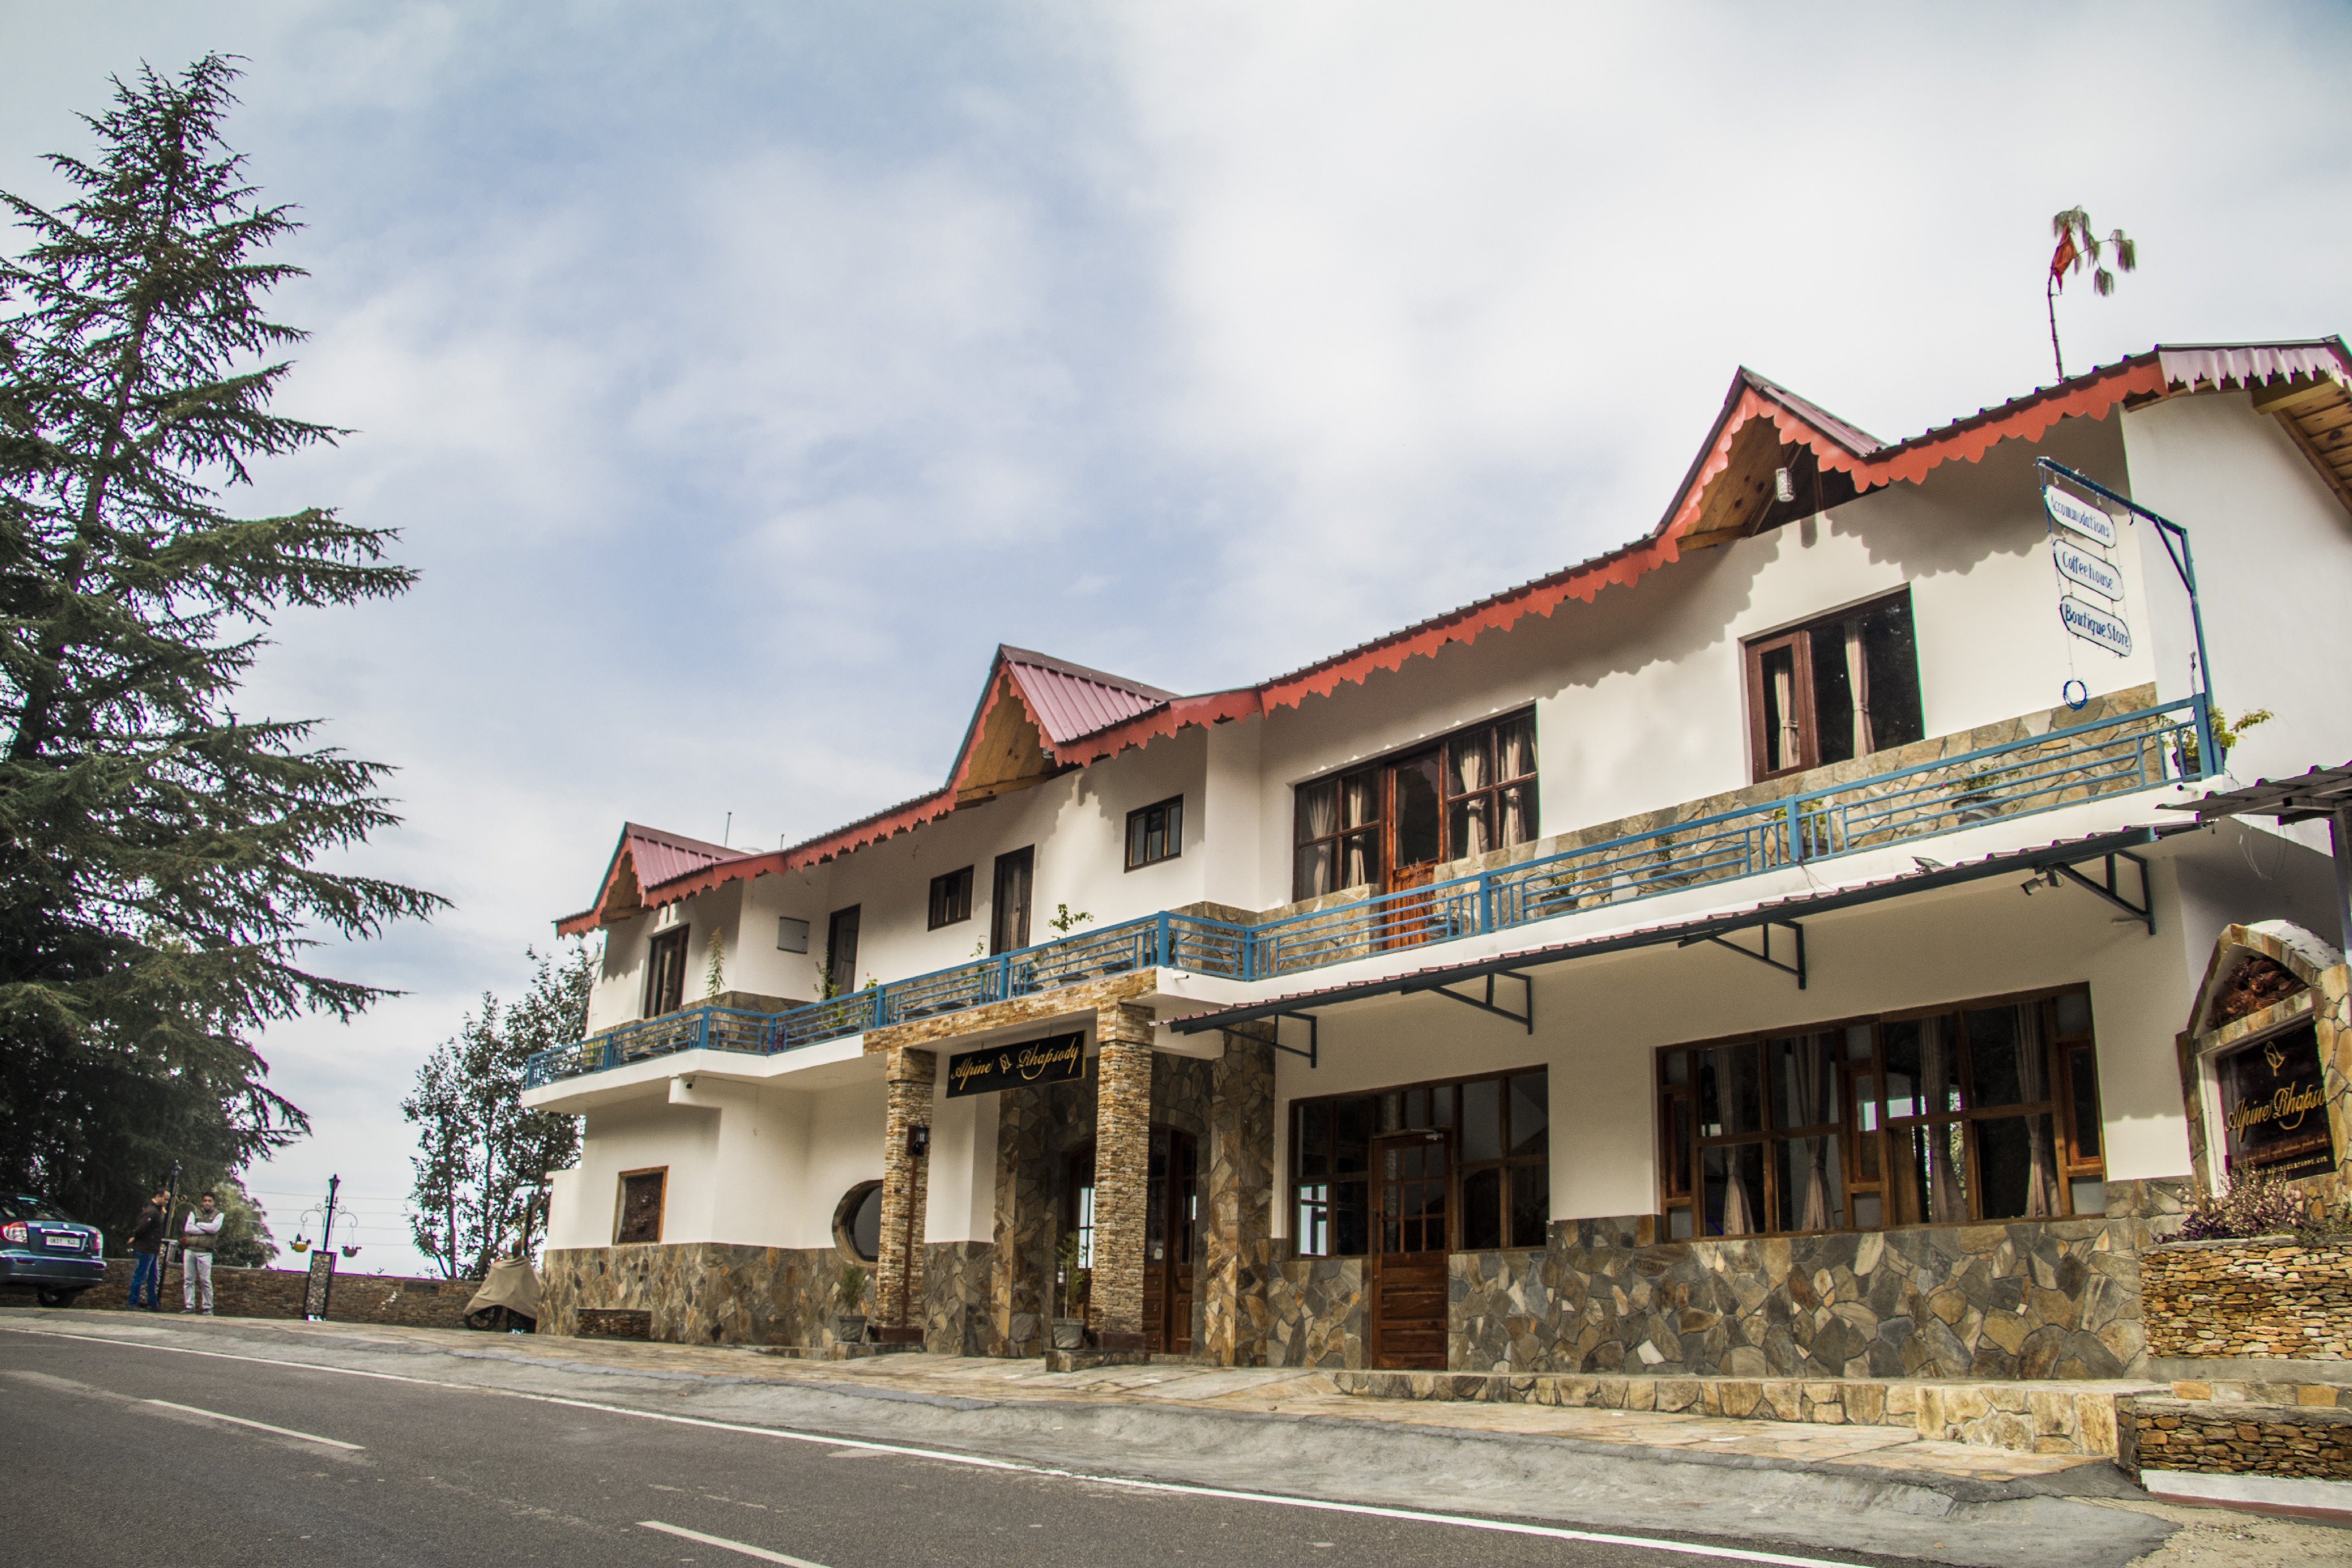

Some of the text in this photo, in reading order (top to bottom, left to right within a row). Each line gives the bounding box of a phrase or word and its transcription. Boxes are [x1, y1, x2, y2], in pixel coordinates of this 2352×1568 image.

[2065, 604, 2130, 647] Boutique Store
[951, 1037, 1080, 1091] Alpine Rhapsody
[2225, 1081, 2326, 1143] Alpine Rhapso
